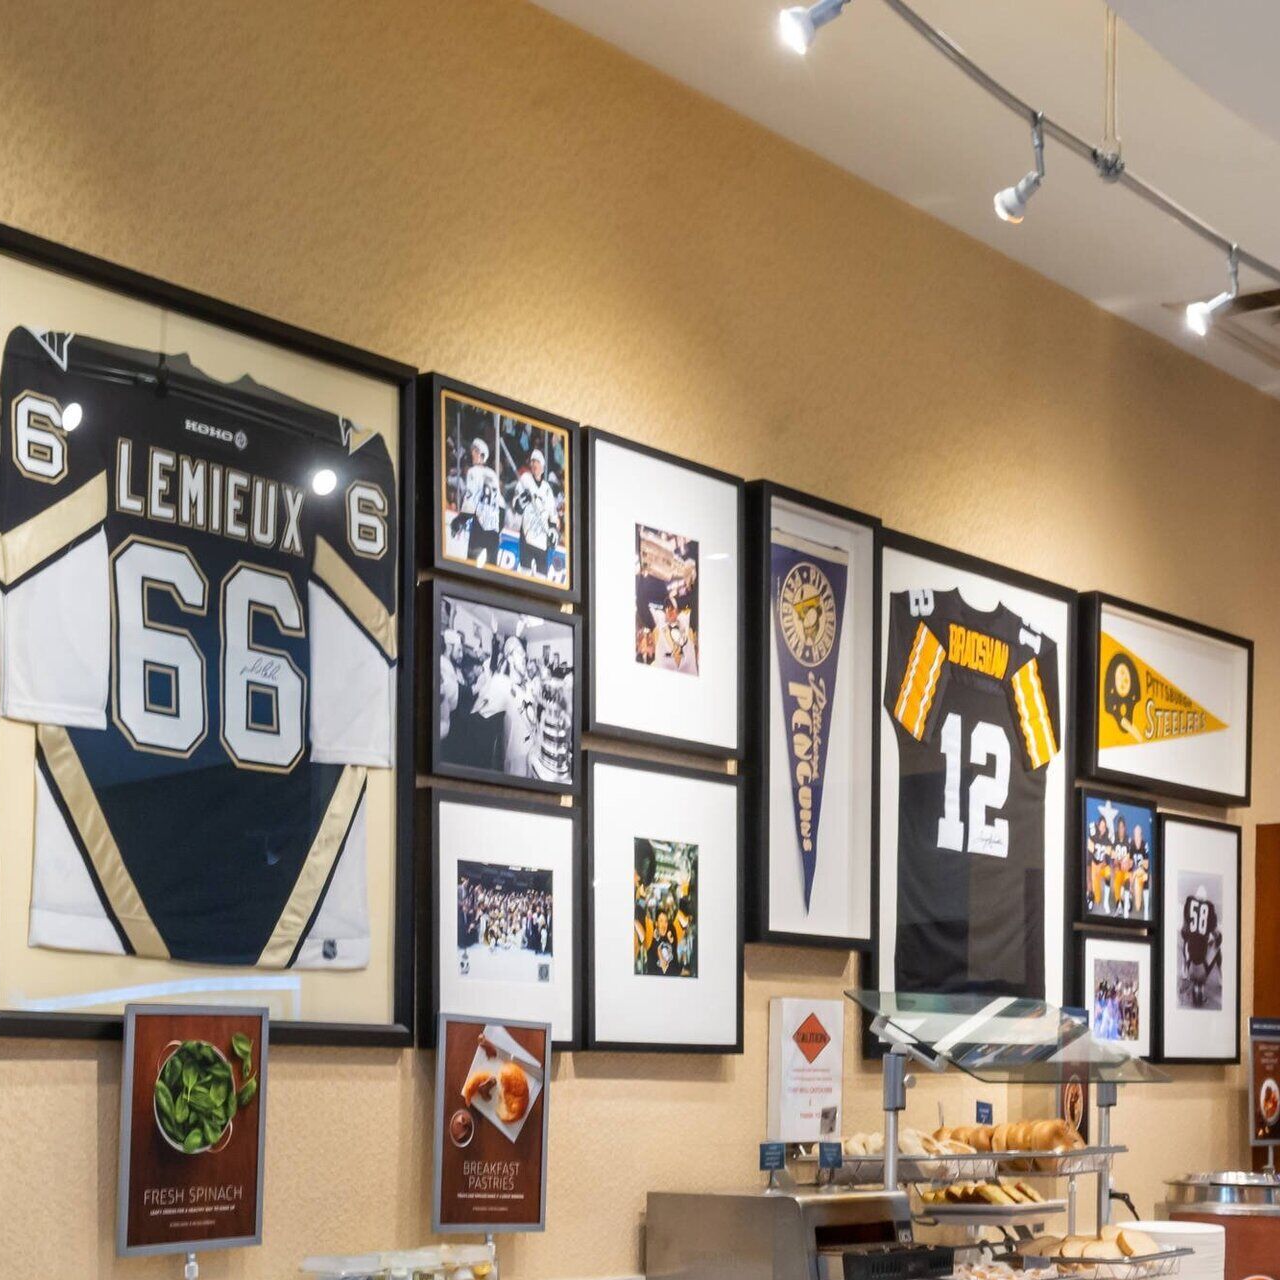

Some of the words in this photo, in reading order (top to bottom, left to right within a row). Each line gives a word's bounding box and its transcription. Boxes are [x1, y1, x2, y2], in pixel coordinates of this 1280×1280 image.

[11, 388, 70, 486] 6
[115, 436, 307, 558] LEMIEUX
[344, 479, 389, 561] 6
[108, 533, 309, 776] 66
[947, 622, 1010, 681] BRADSHAW
[1144, 698, 1207, 741] STEELERS
[788, 680, 814, 852] PENGUINS
[936, 711, 1013, 859] 12
[1189, 899, 1210, 935] 58
[143, 1188, 185, 1206] FRESH
[188, 1184, 243, 1204] SPINACH
[463, 1160, 520, 1176] BREAKFAST
[468, 1175, 515, 1191] PASTRIES
